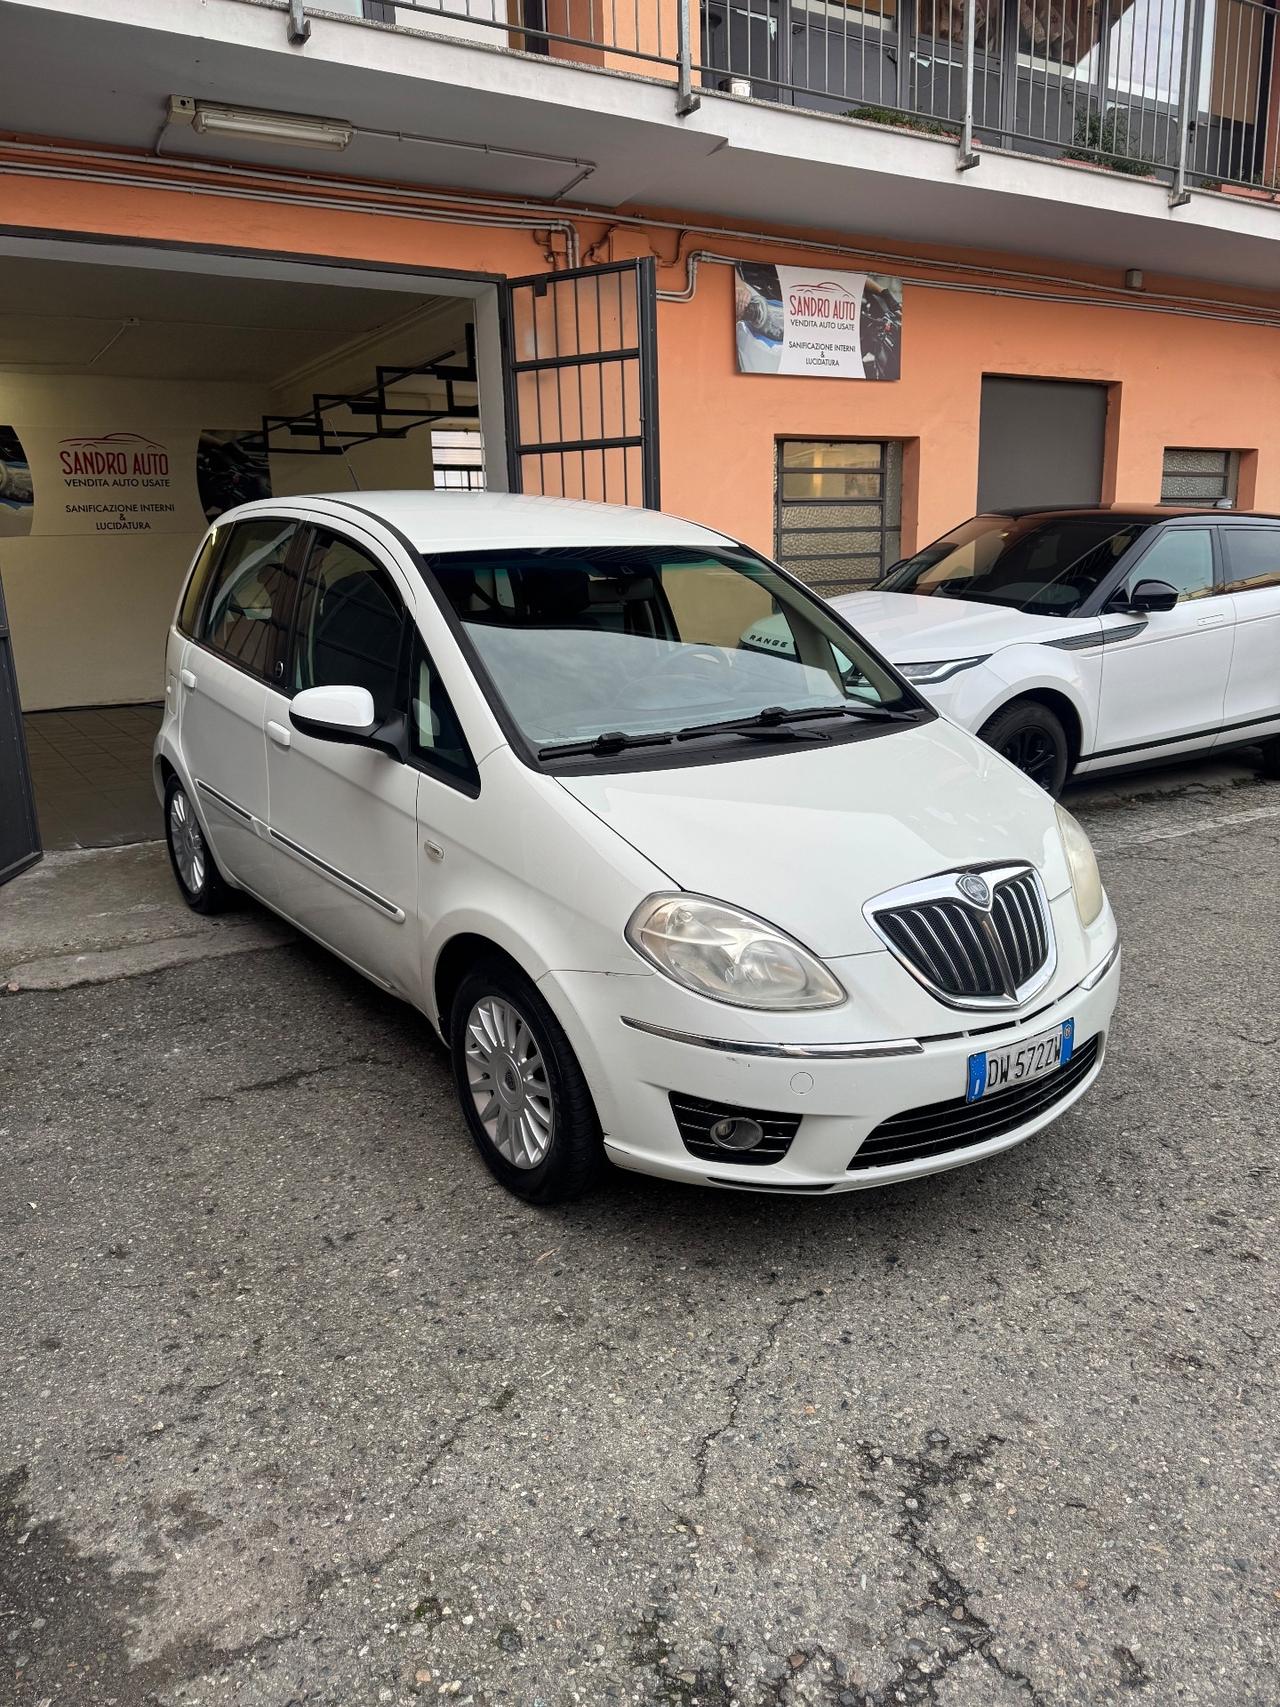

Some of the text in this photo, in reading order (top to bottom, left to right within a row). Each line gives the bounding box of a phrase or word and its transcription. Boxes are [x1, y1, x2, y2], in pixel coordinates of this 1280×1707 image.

[789, 295, 856, 321] SANDRO AUTO
[790, 319, 855, 331] VENDITA AUTO USATE
[788, 341, 856, 352] SANIFICAZIONE INTERNI
[805, 358, 840, 367] LUCIDATURA
[60, 451, 169, 475] SANDRO AUTO
[64, 478, 171, 488] VENDITA AUTO USATE
[65, 504, 175, 513] SANIFICAZIONE INTERNI
[119, 513, 126, 521] &
[96, 521, 151, 530] LUCIDATURA
[749, 634, 788, 648] RANGE
[987, 1034, 1062, 1087] DW 572ZW
